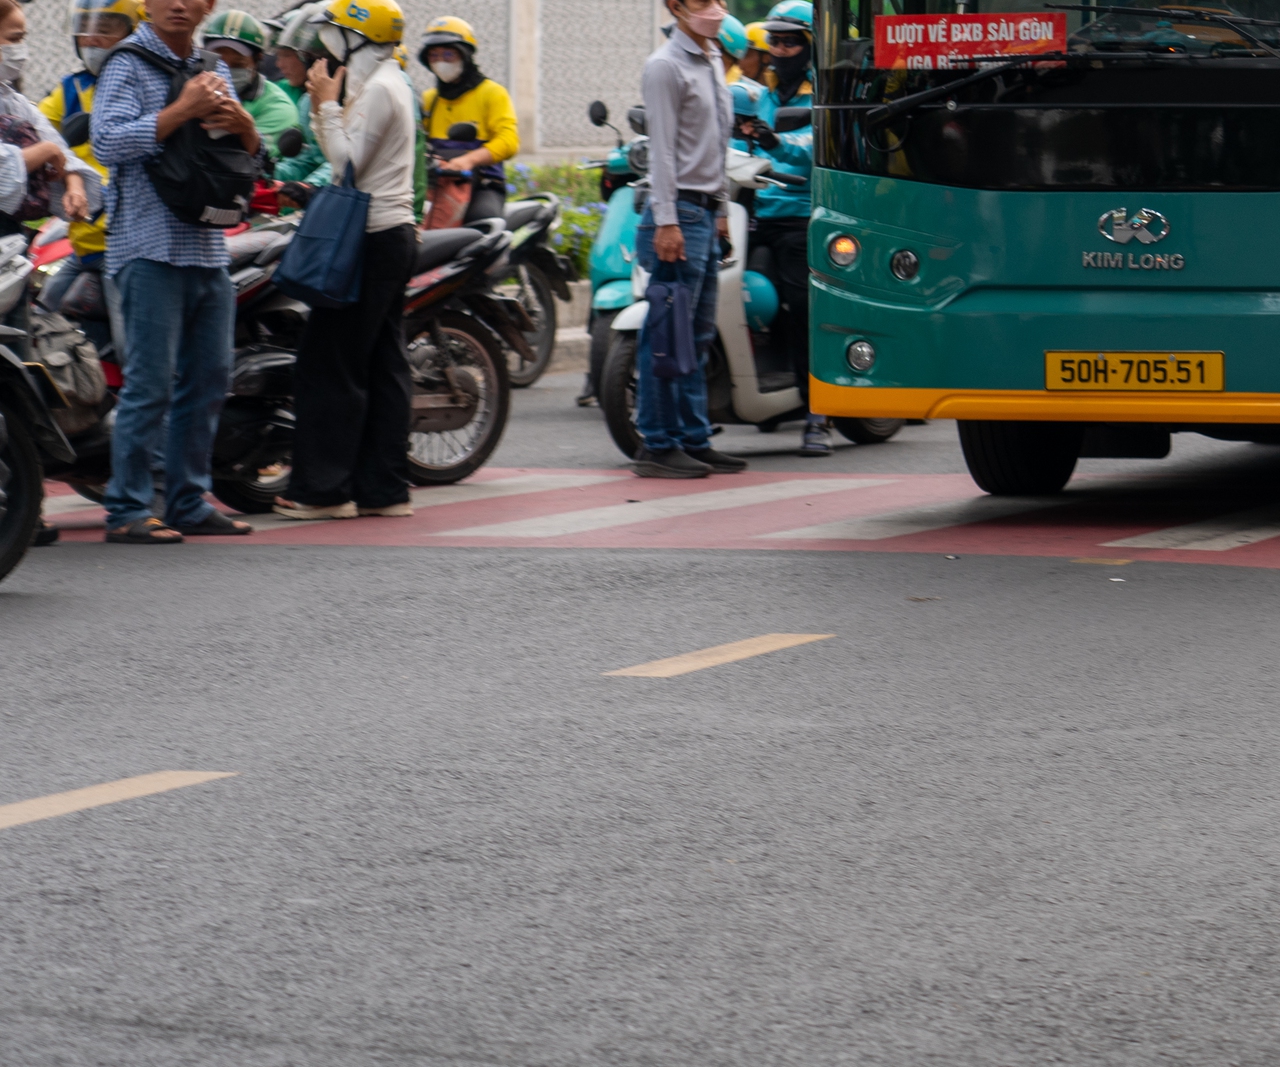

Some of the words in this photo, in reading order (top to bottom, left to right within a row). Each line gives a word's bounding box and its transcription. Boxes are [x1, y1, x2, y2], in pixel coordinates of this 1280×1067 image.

[346, 0, 370, 22] be
[927, 17, 948, 43] VỀ
[951, 22, 983, 42] BXB
[987, 18, 1014, 42] SÀI
[1018, 17, 1054, 41] GÒN
[1082, 251, 1123, 270] KIM
[1128, 252, 1185, 271] LONG
[1060, 359, 1206, 385] 50H-705.51
